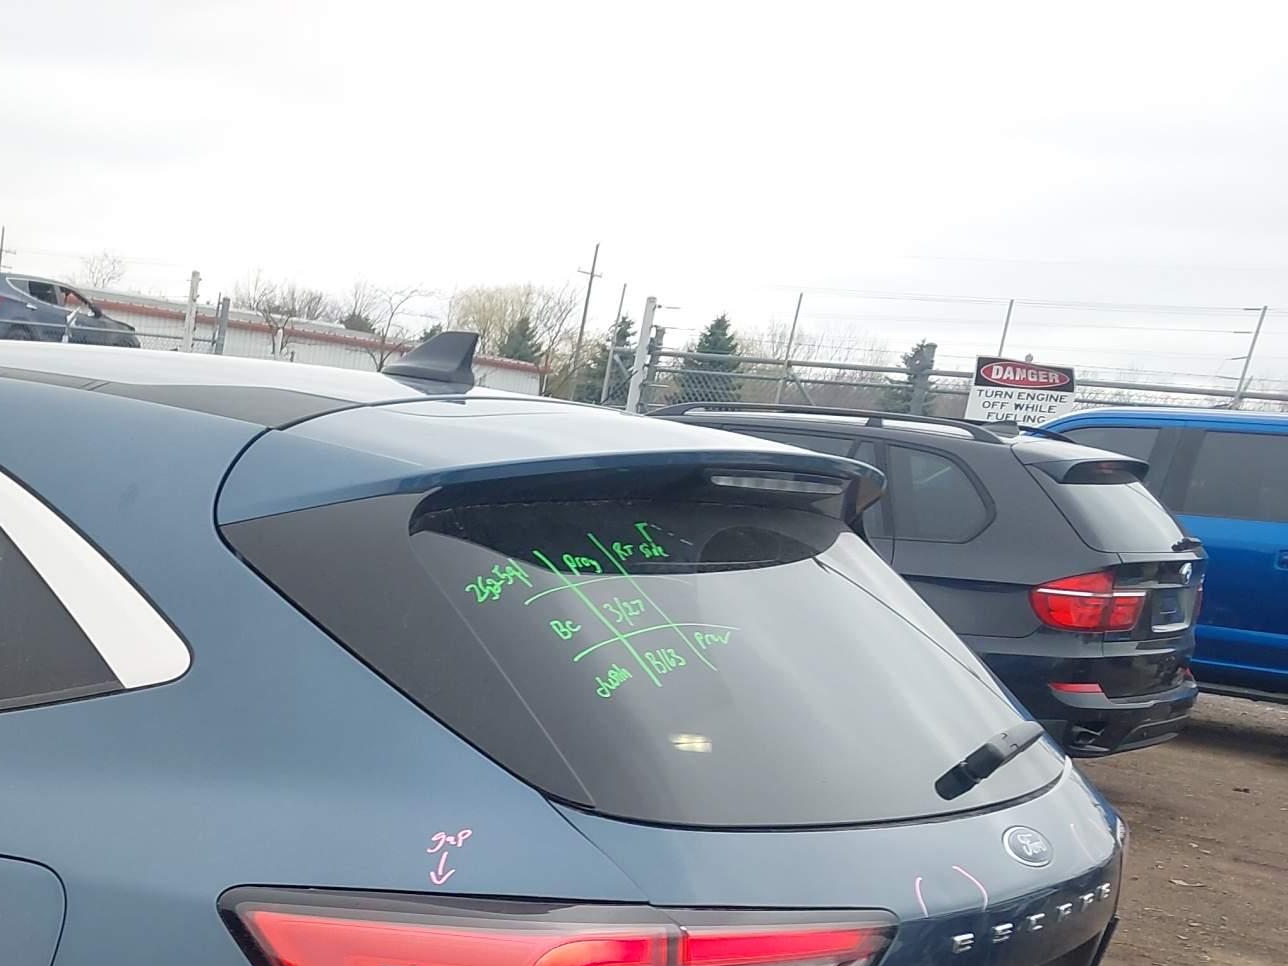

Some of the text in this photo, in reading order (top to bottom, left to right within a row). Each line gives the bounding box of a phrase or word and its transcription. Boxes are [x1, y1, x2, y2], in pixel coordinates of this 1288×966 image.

[992, 365, 1060, 383] DANGER
[977, 389, 1068, 403] TURN ENGINE
[982, 401, 1057, 414] OFF WHILE
